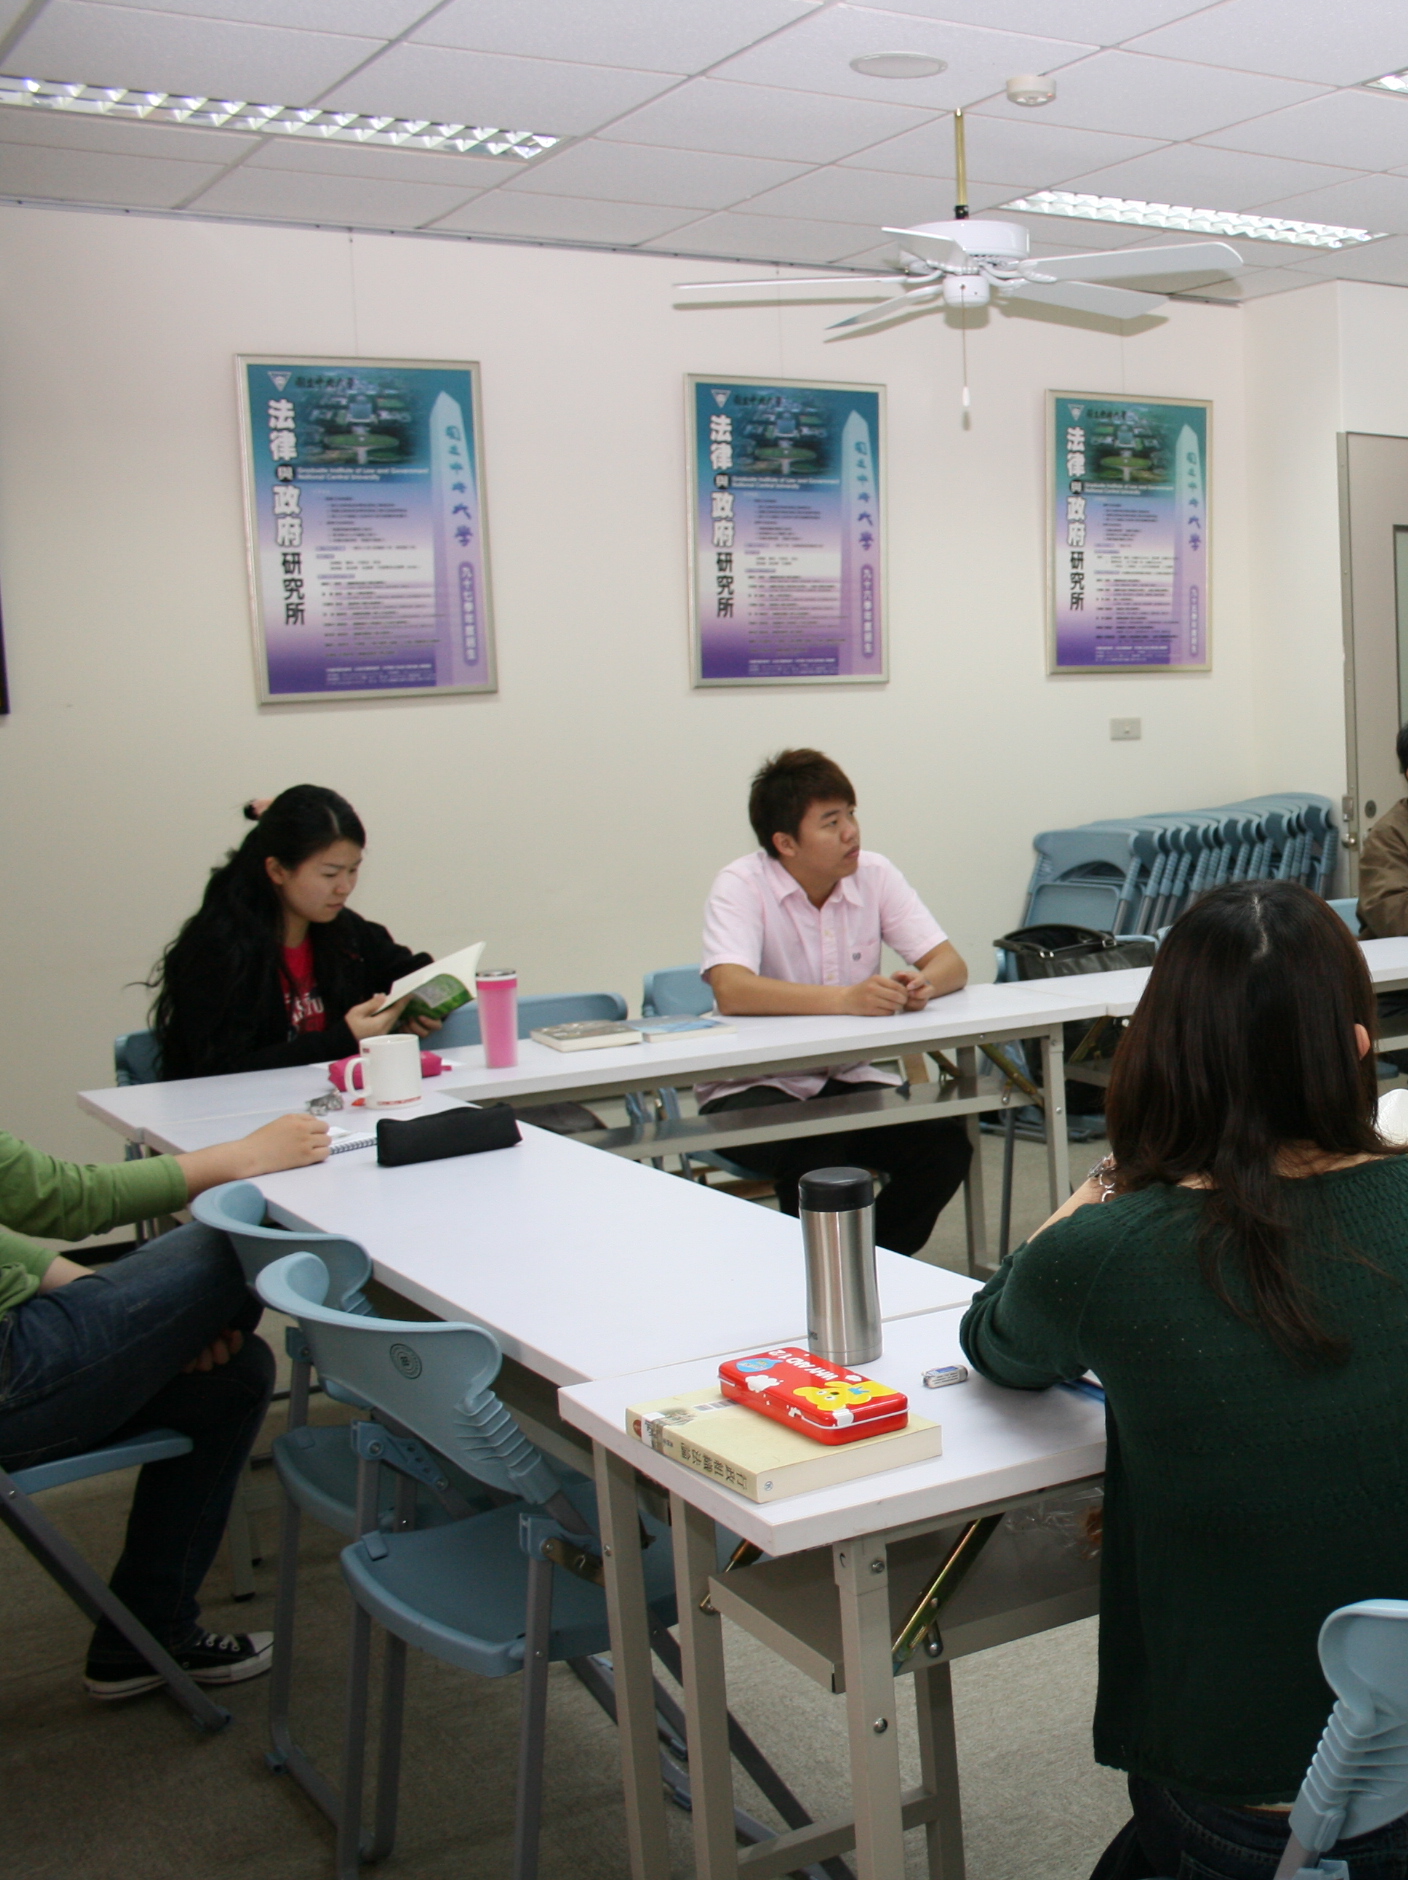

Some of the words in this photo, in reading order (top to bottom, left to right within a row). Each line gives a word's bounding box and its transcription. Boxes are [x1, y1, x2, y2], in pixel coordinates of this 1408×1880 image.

[266, 398, 307, 627] 法律與政府研究所
[709, 413, 736, 619] 法律與政府研究所
[1065, 426, 1088, 612] 法律與政府研究所
